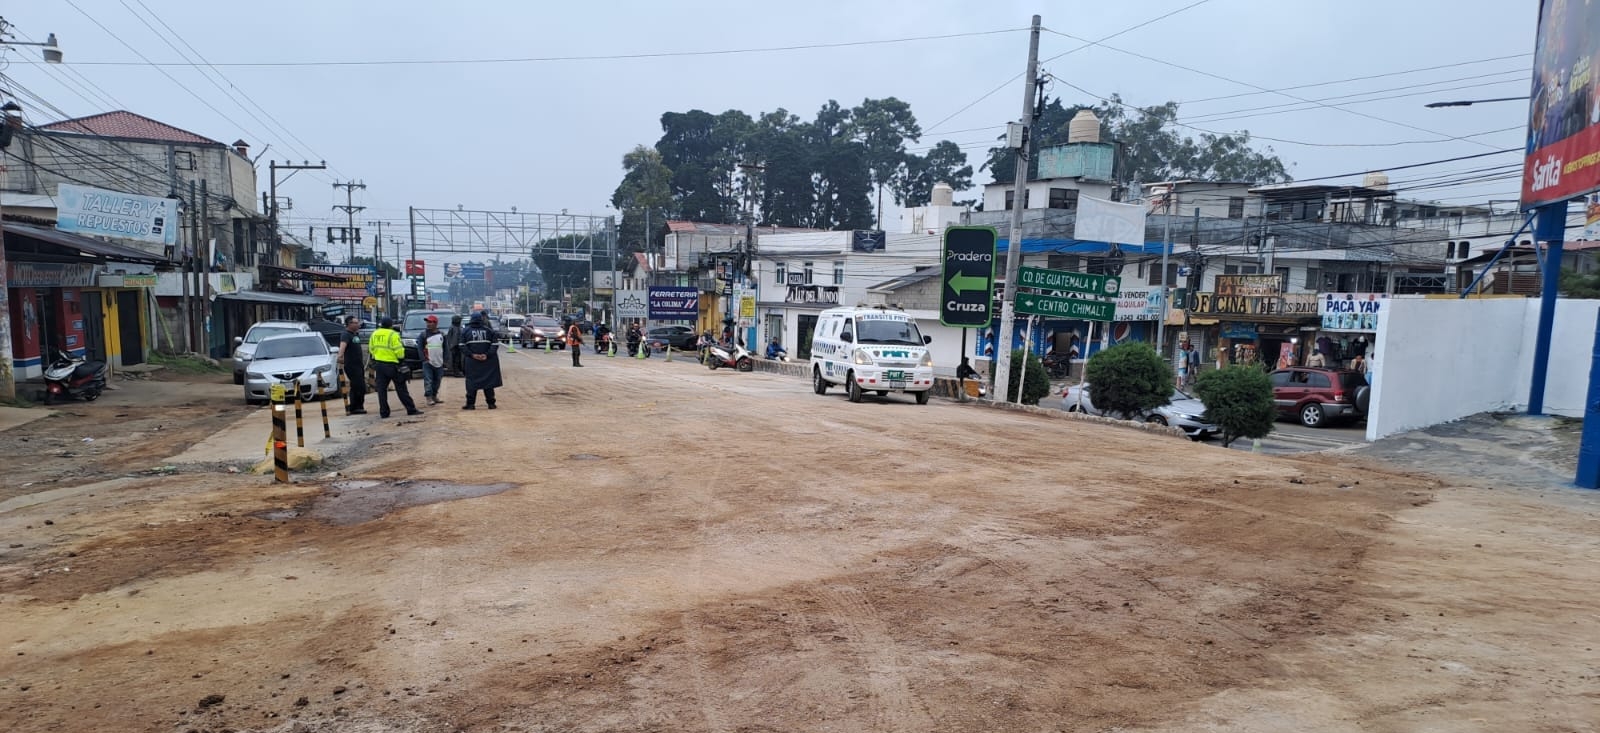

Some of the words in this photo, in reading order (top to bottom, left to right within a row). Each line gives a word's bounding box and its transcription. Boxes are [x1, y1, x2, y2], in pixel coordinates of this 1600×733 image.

[1532, 156, 1561, 192] Sarita
[83, 192, 142, 218] TALLER
[145, 202, 158, 219] Y
[77, 213, 150, 236] REPUESTOS
[947, 250, 992, 262] Pradera
[1022, 271, 1034, 283] CD.
[1035, 272, 1045, 284] DE
[1046, 273, 1089, 289] GUATEMALA
[816, 286, 838, 303] MUNDO
[947, 300, 986, 312] Cruza
[1037, 299, 1069, 313] CENTRO
[1071, 303, 1107, 317] CHIMALT.
[1190, 295, 1247, 313] OFCINA
[1326, 301, 1355, 313] PACA
[471, 330, 487, 341] PMT
[882, 350, 910, 358] PMT
